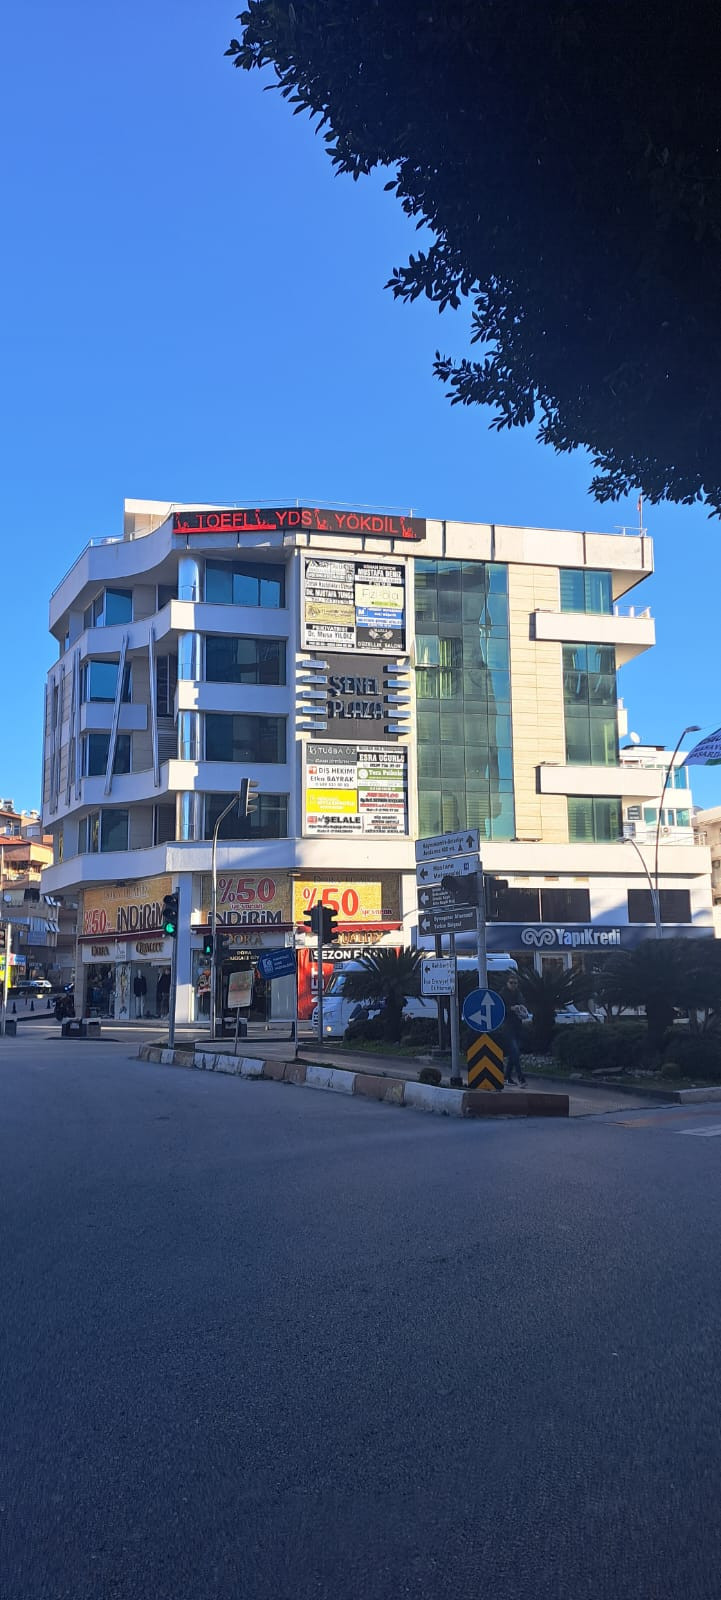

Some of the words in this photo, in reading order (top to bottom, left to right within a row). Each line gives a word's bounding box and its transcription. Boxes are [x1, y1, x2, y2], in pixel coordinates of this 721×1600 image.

[196, 511, 250, 529] TOEFL
[275, 510, 313, 526] YDS
[334, 512, 399, 534] YÖKDİL
[357, 568, 384, 577] MUSTAFA
[328, 675, 383, 697] ŞENEL
[327, 699, 385, 720] PLAZA
[359, 753, 377, 762] ESRA
[218, 878, 276, 904] %50
[555, 928, 621, 948] YapıKredi
[313, 950, 352, 960] SEZON
